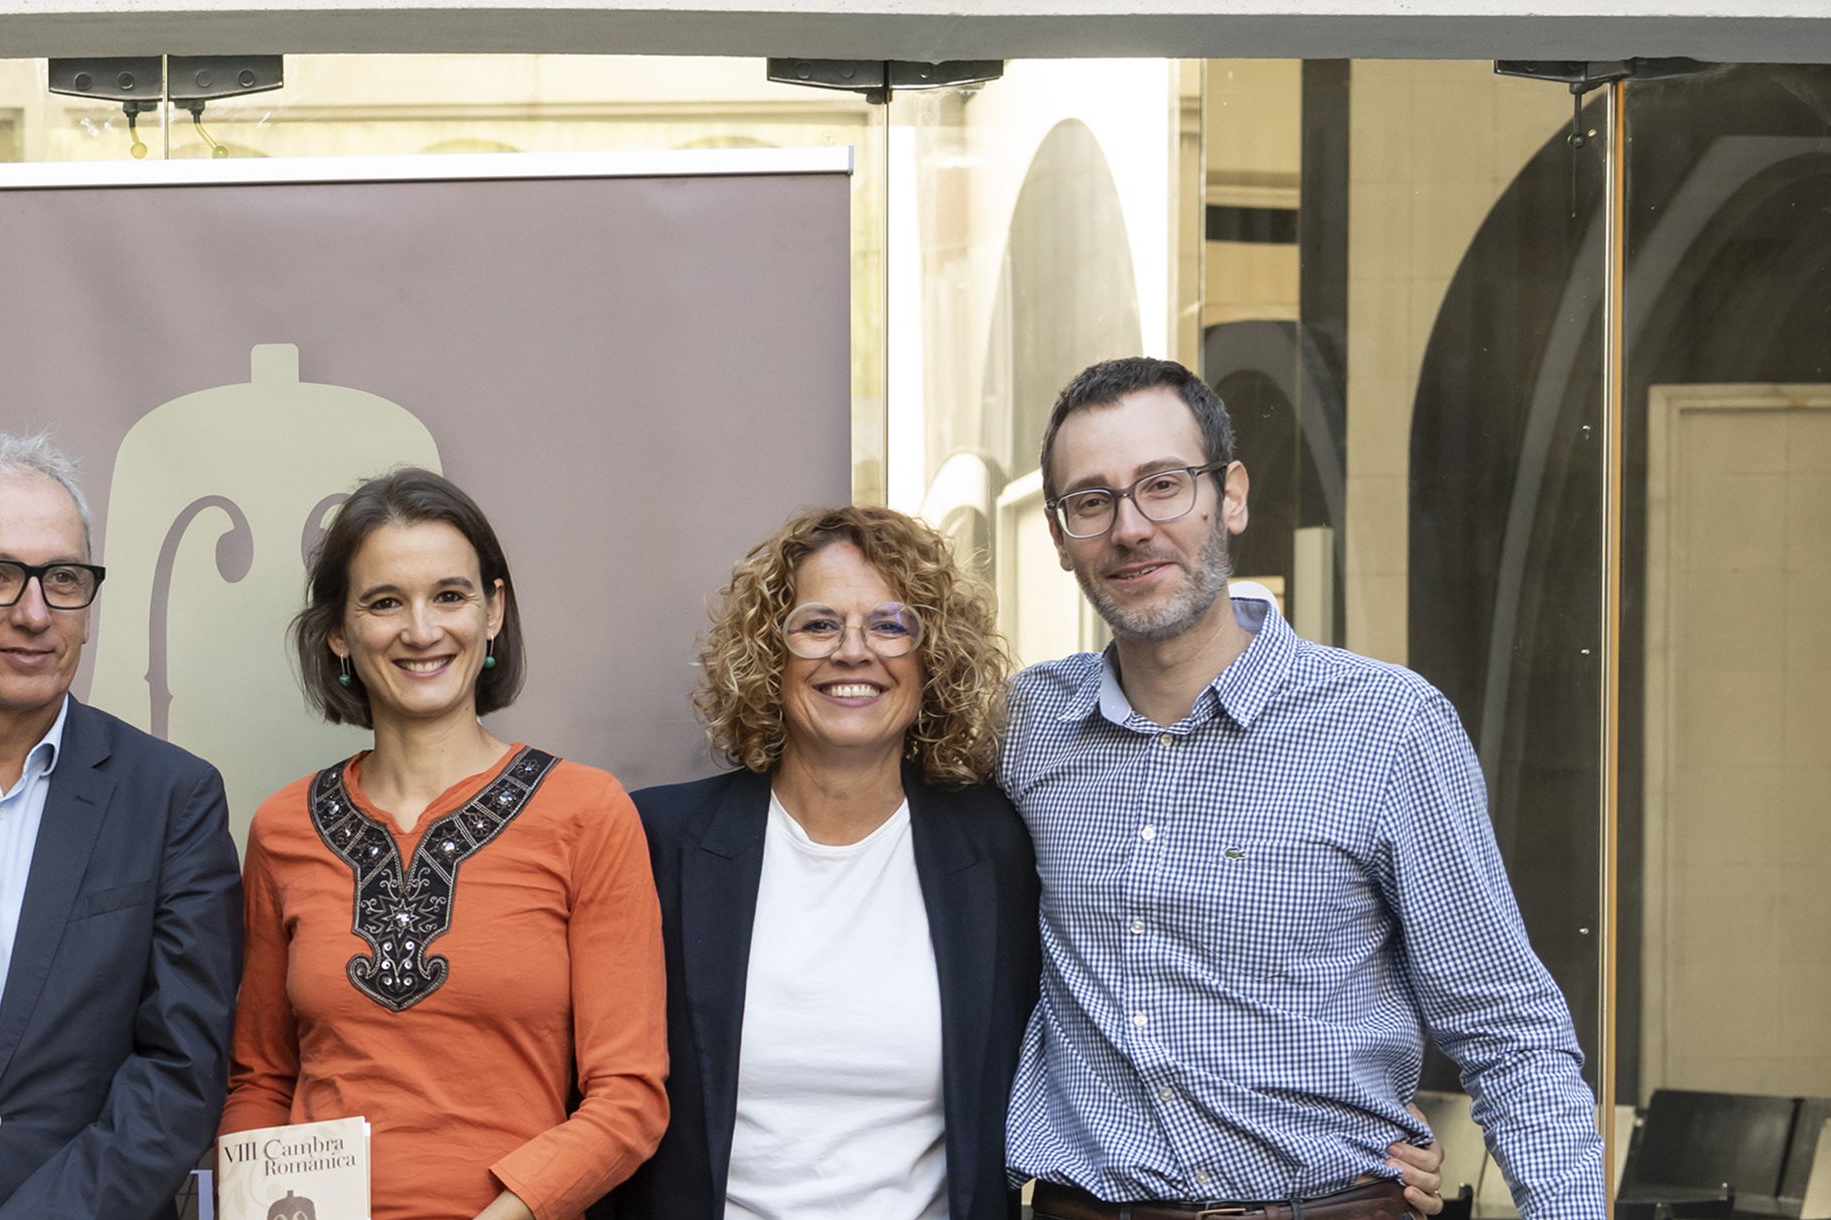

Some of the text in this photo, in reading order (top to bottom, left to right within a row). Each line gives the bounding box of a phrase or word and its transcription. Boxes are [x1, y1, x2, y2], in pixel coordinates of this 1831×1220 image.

[224, 1137, 344, 1164] VIII Cambra
[265, 1153, 356, 1176] Romànica
